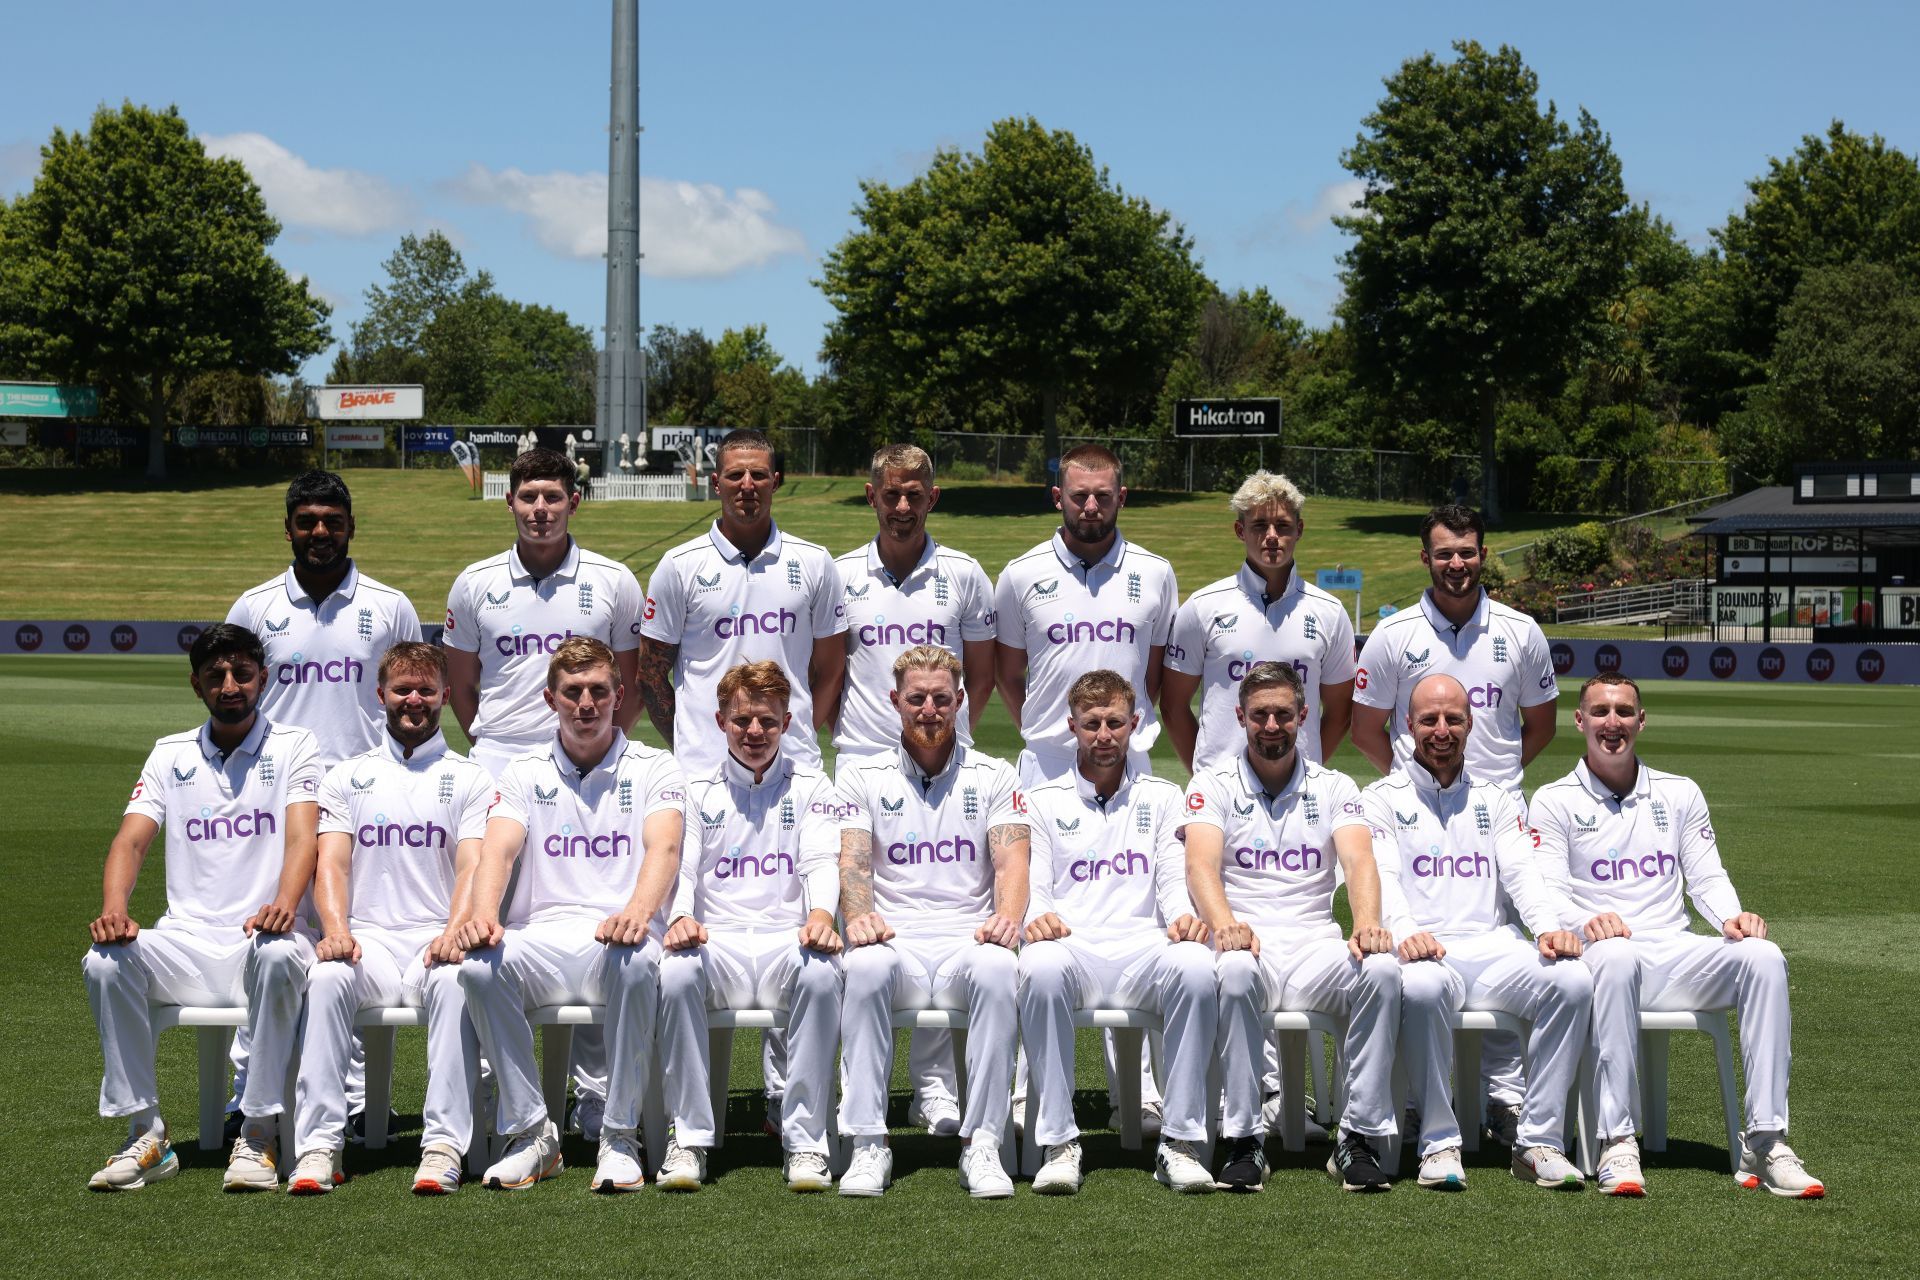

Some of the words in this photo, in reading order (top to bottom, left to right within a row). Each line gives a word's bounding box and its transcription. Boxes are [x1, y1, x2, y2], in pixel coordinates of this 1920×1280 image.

[340, 392, 396, 409] BRAVE
[1190, 404, 1265, 425] Hikotron
[199, 432, 237, 441] MEDIA
[270, 432, 308, 441] MEDIA
[404, 432, 449, 440] NOVOTEL
[469, 431, 517, 443] hamilton
[662, 430, 694, 450] prin
[1733, 539, 1749, 550] BRB
[714, 603, 796, 640] cinch
[859, 614, 946, 646] cinch
[1047, 612, 1135, 645] cinch
[1717, 610, 1736, 622] BAR
[278, 651, 364, 686] cinch
[186, 807, 275, 842] cinch
[358, 813, 447, 849] cinch
[544, 824, 631, 858] cinch
[887, 831, 976, 865] cinch
[1235, 838, 1322, 872] cinch
[1412, 845, 1491, 879] cinch
[1069, 848, 1149, 882] cinch
[1590, 848, 1676, 882] cinch
